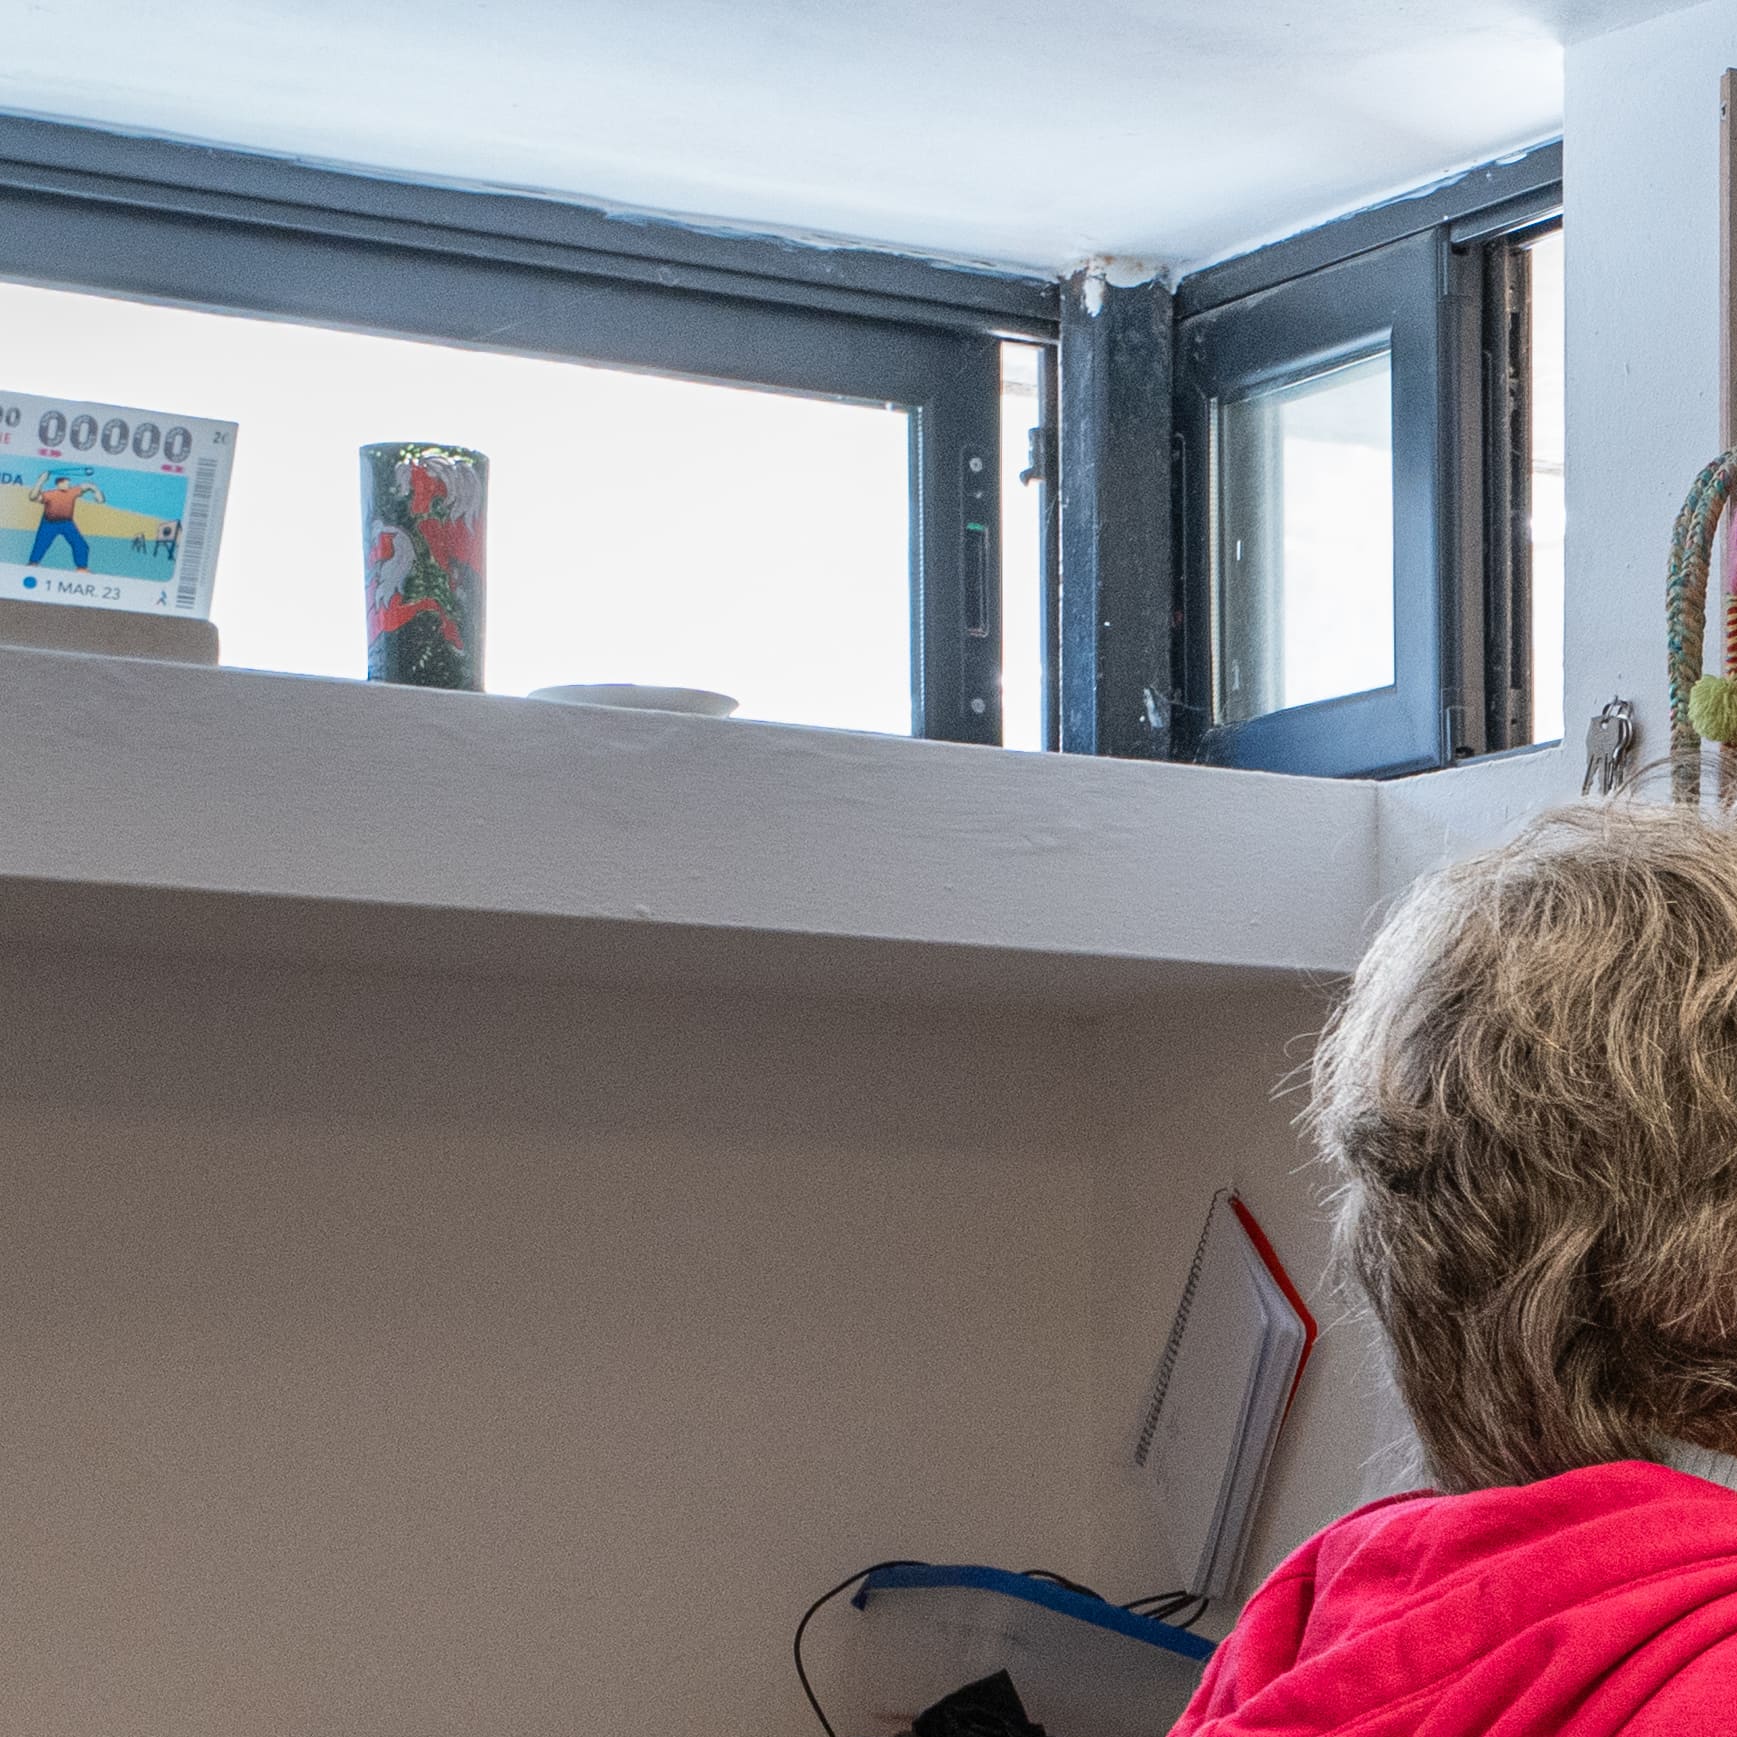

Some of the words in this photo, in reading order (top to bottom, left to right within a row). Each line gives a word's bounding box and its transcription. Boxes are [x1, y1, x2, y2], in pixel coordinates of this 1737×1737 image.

[38, 410, 193, 463] 00000
[0, 472, 23, 486] DA
[45, 580, 51, 591] 1
[57, 582, 98, 599] MAR.
[102, 587, 121, 600] 23
